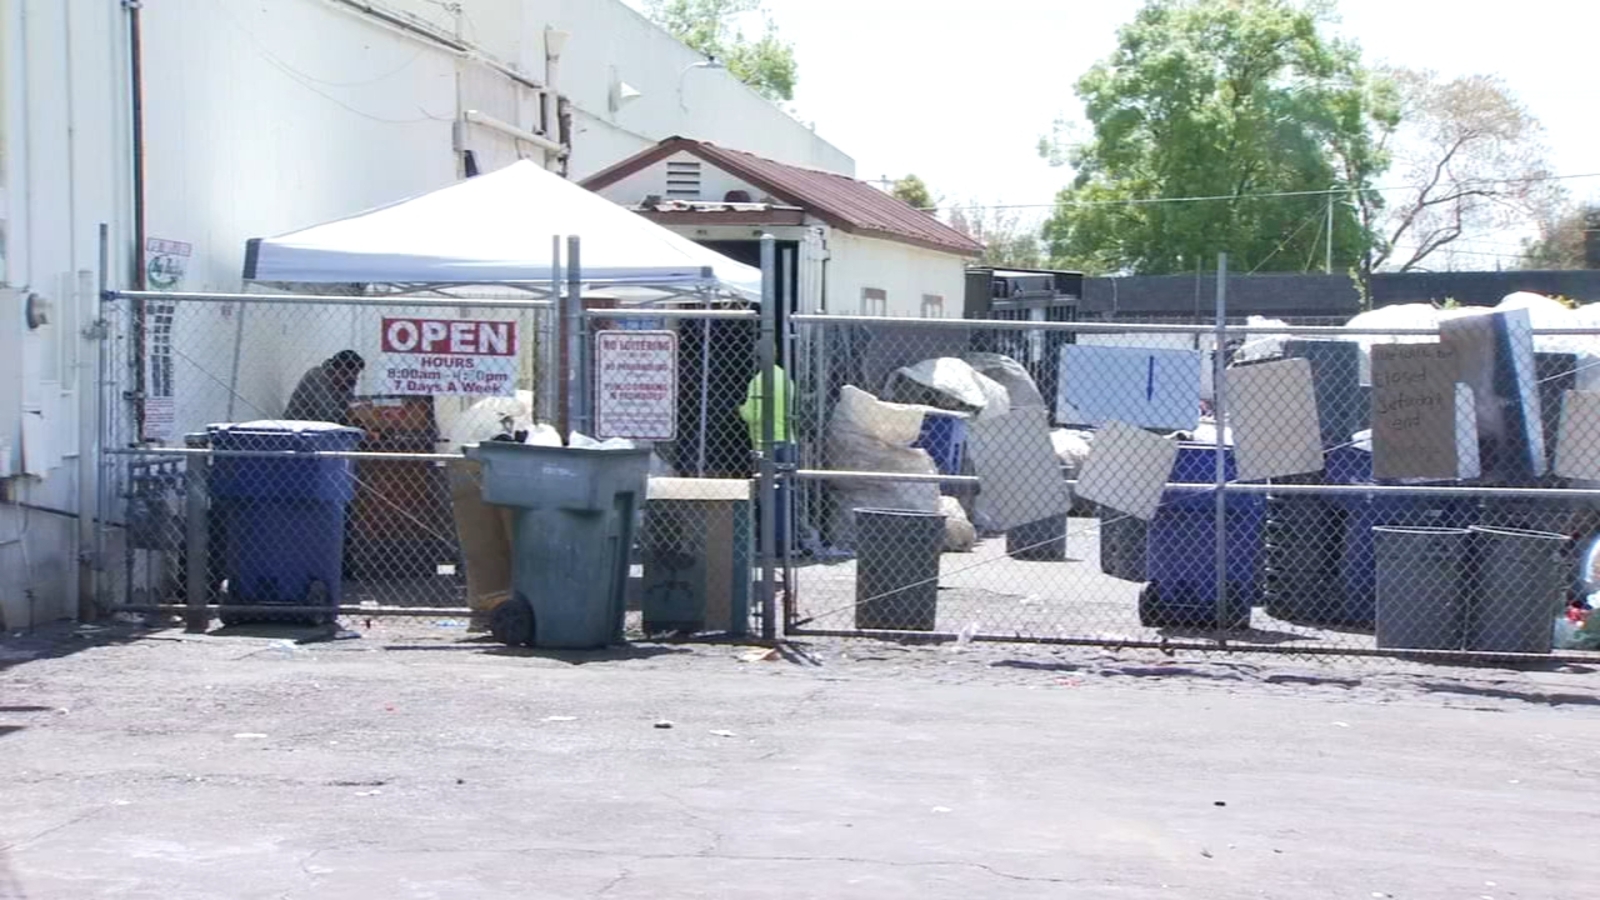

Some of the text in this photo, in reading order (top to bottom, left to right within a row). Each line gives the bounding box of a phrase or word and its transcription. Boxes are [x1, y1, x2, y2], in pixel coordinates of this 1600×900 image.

[387, 320, 508, 354] OPEN
[603, 340, 617, 351] NO
[421, 356, 475, 369] HOURS
[387, 368, 441, 380] 8:00am
[393, 380, 402, 391] 7
[447, 381, 458, 392] A
[461, 380, 502, 394] Week
